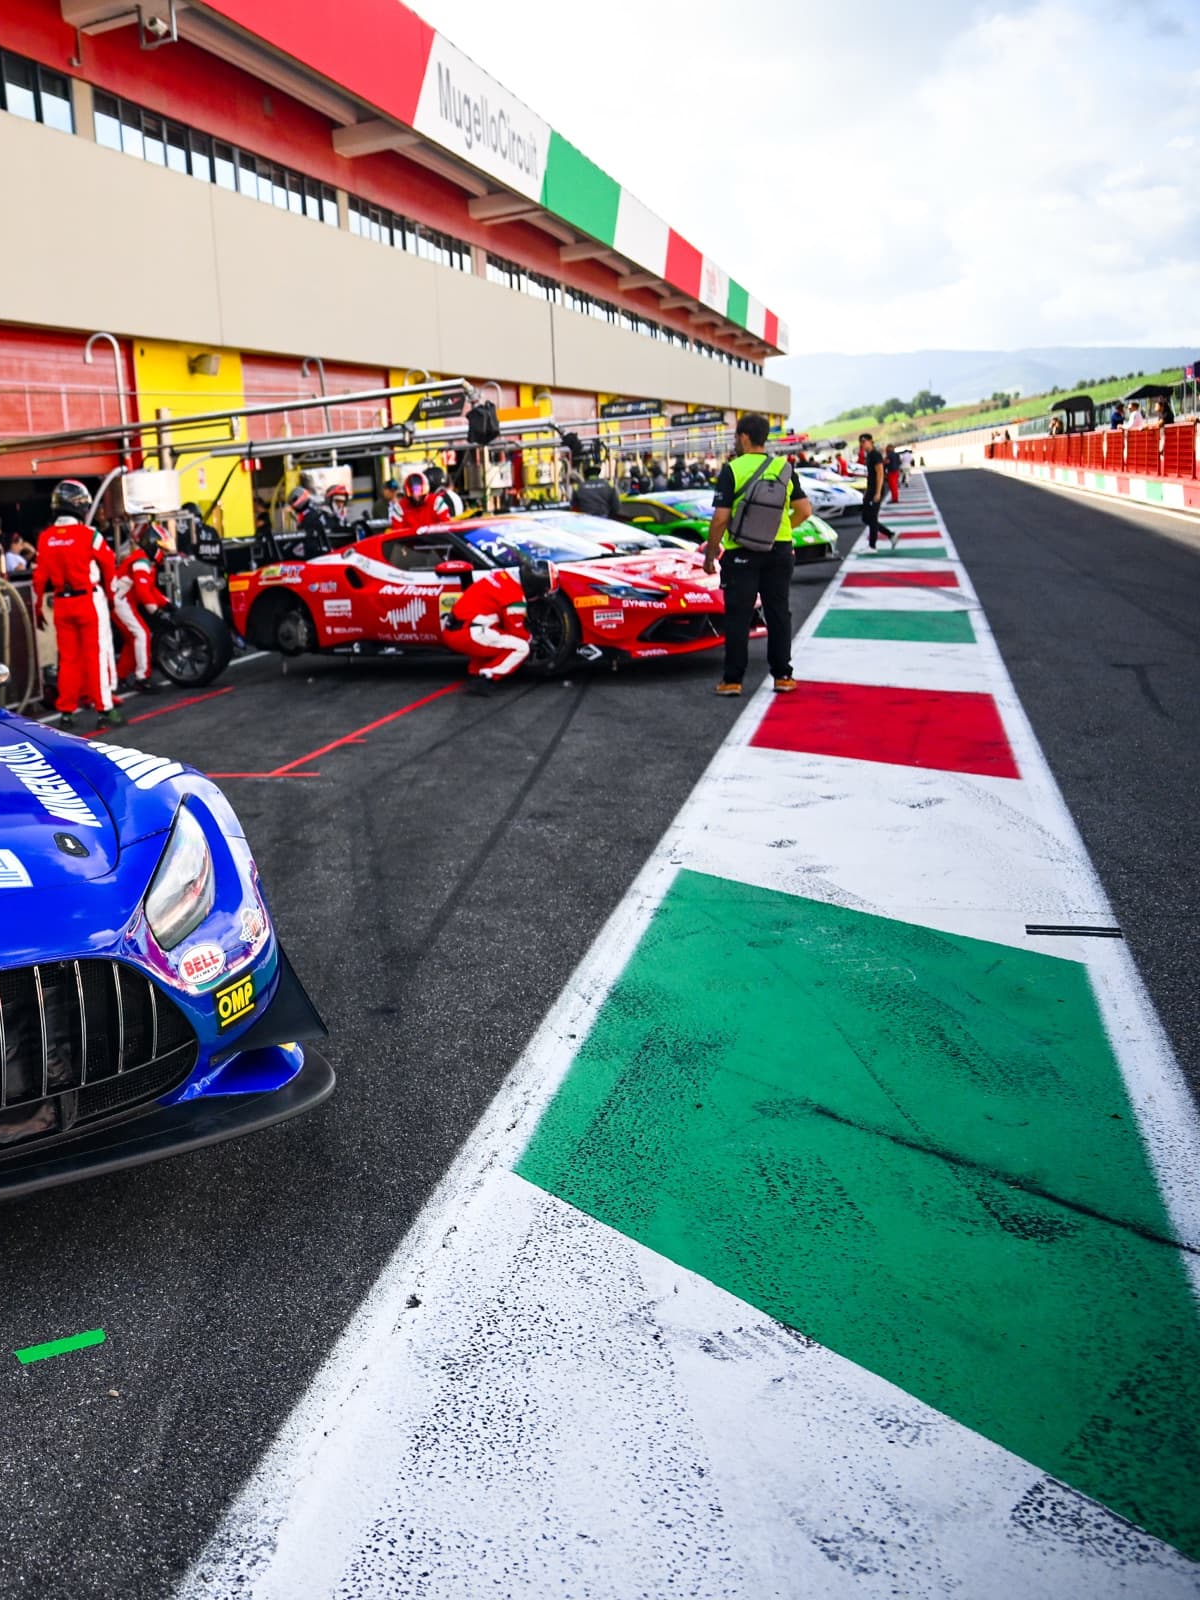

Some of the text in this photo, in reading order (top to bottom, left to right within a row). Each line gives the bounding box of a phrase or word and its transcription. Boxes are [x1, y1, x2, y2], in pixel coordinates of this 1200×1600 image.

[437, 60, 538, 181] MugelloCircuit
[183, 950, 220, 978] BELL
[218, 982, 253, 1018] OMP
